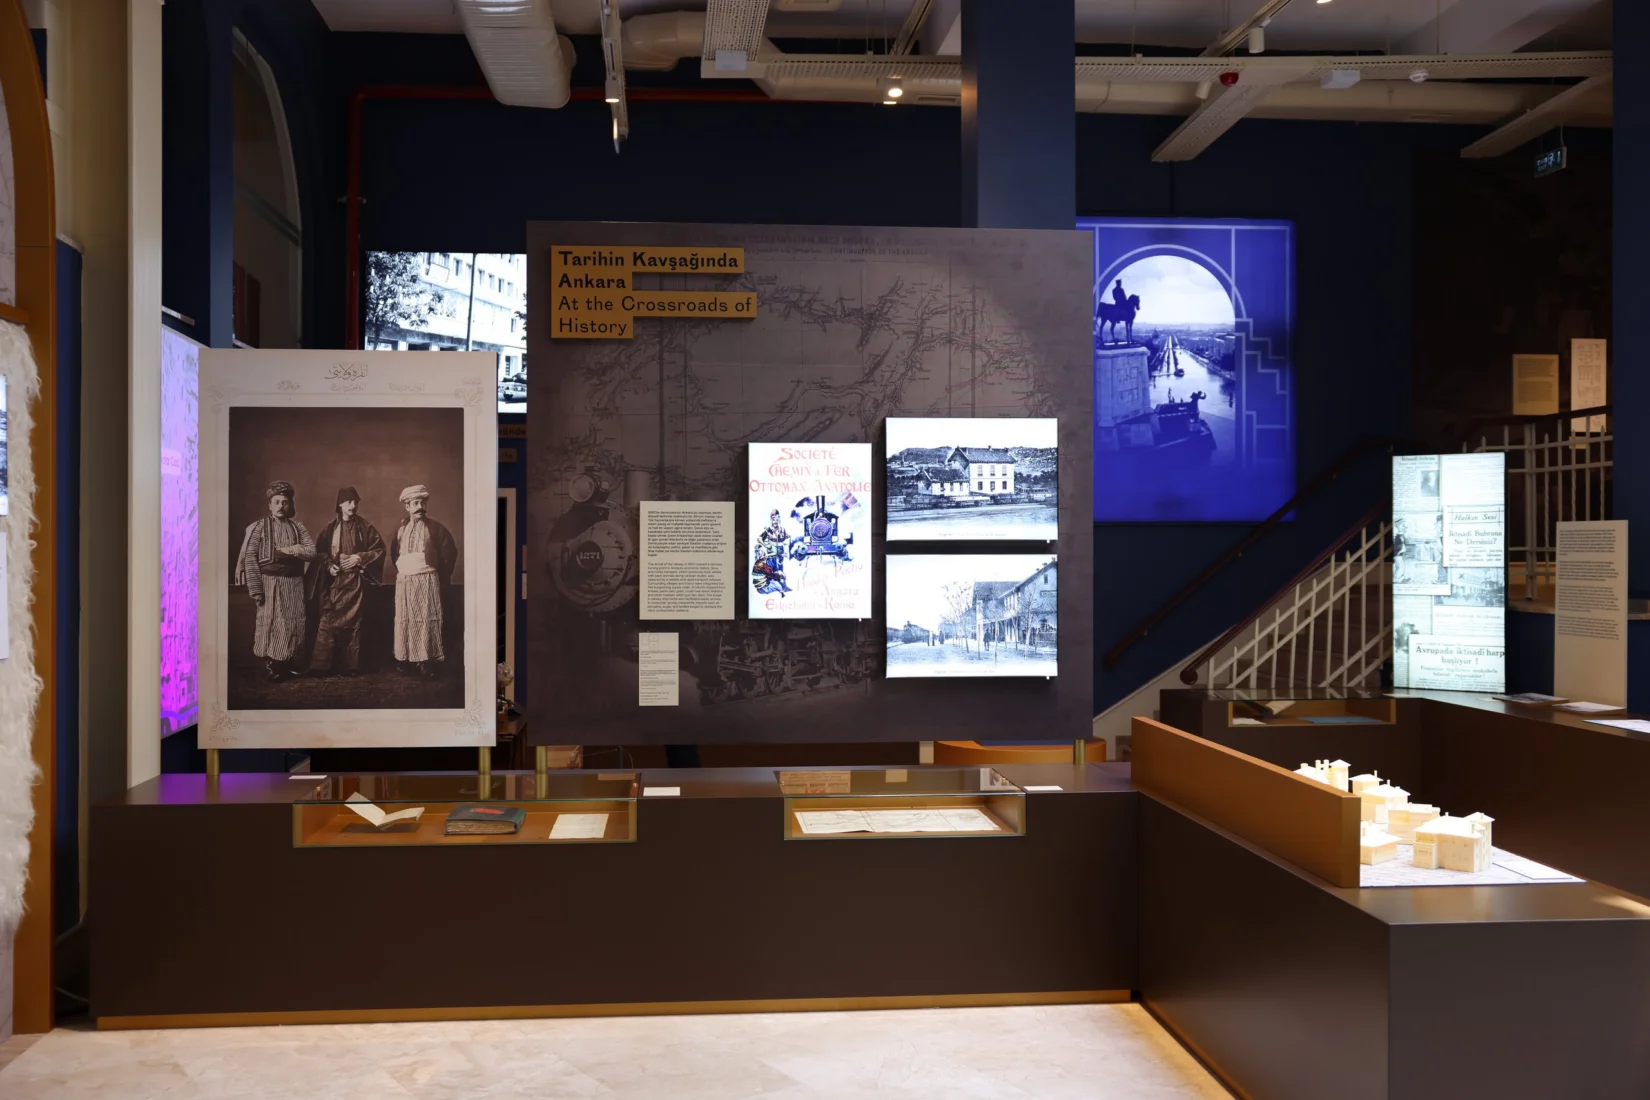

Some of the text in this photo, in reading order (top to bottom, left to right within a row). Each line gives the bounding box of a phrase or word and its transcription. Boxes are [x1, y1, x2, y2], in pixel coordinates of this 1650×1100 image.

[558, 250, 625, 267] Tarihin
[632, 251, 739, 271] Kavşağında
[558, 273, 627, 289] Ankara
[558, 295, 752, 312] At the Crossroads of
[559, 317, 627, 336] History
[579, 552, 600, 560] 1271
[1416, 645, 1453, 655] Avrupada
[1486, 648, 1505, 658] harp
[1441, 656, 1472, 665] başlıyor
